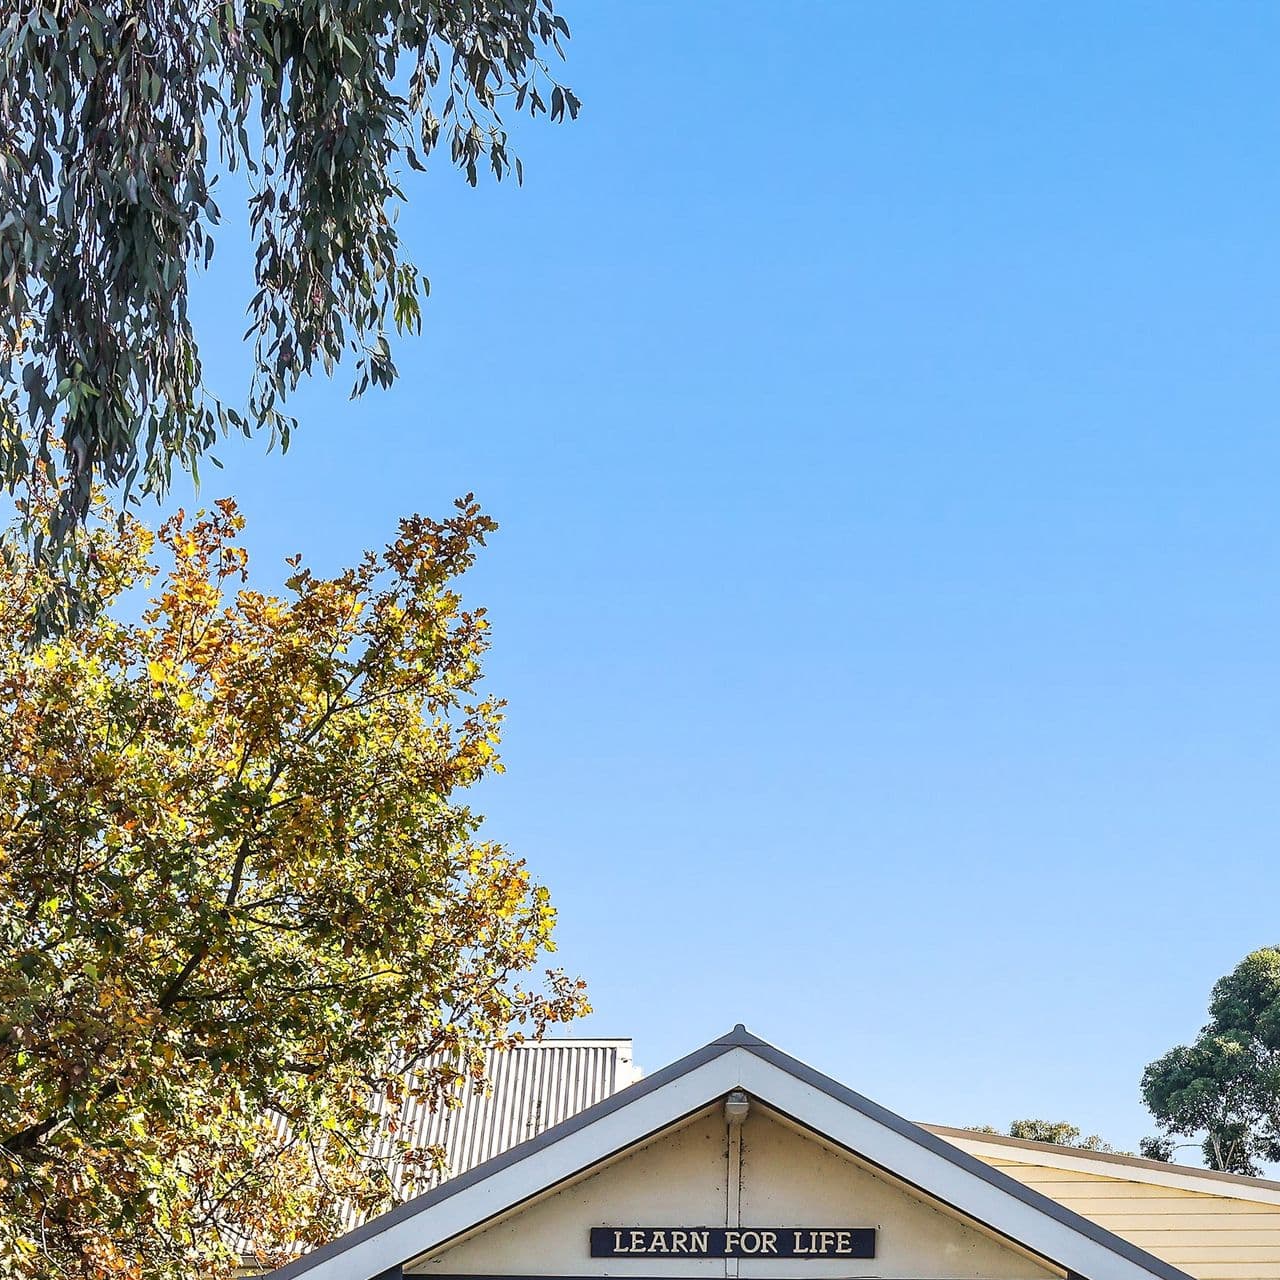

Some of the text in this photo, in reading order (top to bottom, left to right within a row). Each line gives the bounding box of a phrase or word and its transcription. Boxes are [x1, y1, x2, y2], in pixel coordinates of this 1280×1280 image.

[613, 1231, 853, 1254] LEARN FOR LIFE
